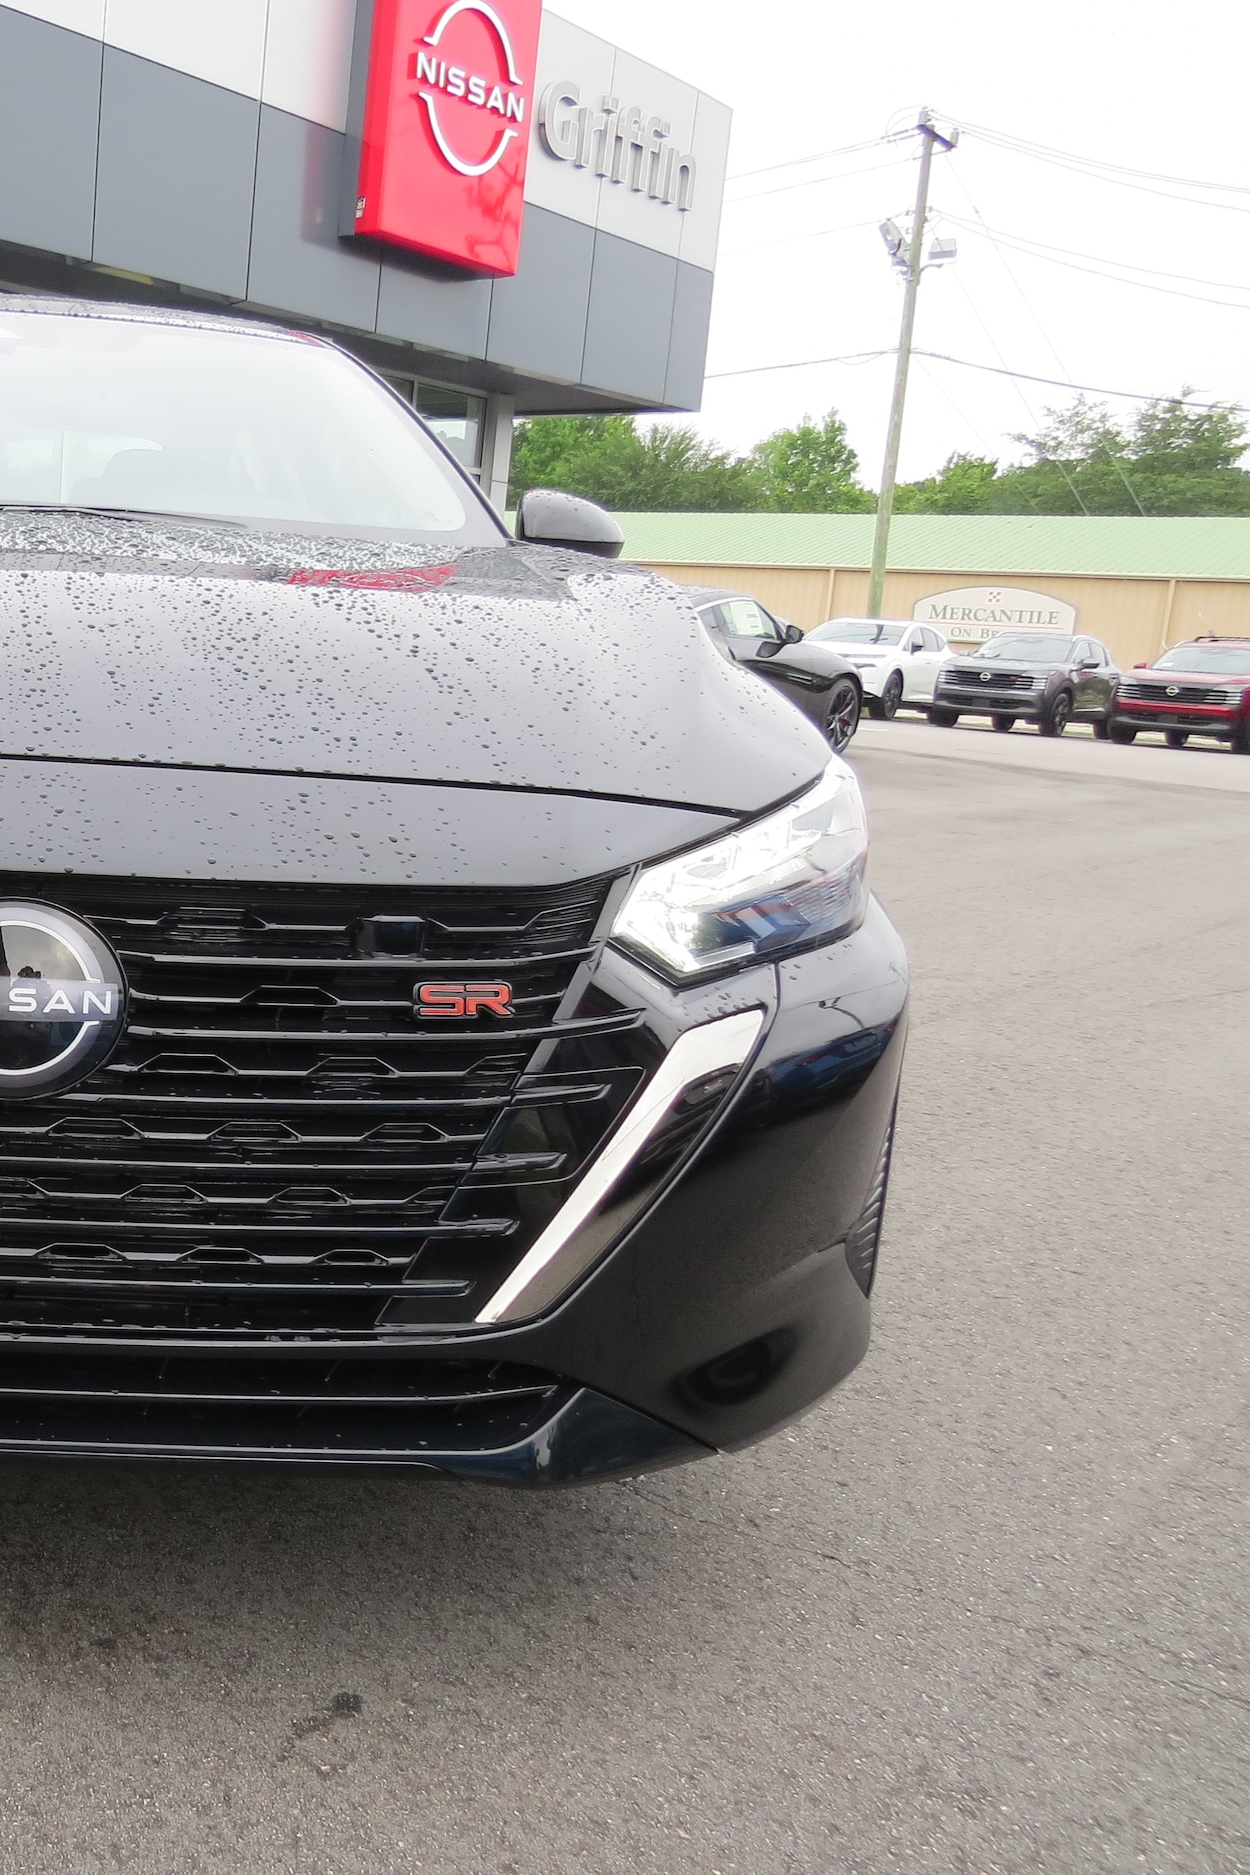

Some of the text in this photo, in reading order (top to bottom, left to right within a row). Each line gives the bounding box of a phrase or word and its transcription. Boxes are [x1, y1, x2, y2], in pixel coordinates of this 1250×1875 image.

[416, 51, 525, 123] NISSAN
[538, 81, 698, 212] Griffin
[929, 604, 1059, 624] MERCANTILE
[950, 626, 972, 639] ON
[416, 982, 514, 1018] SR
